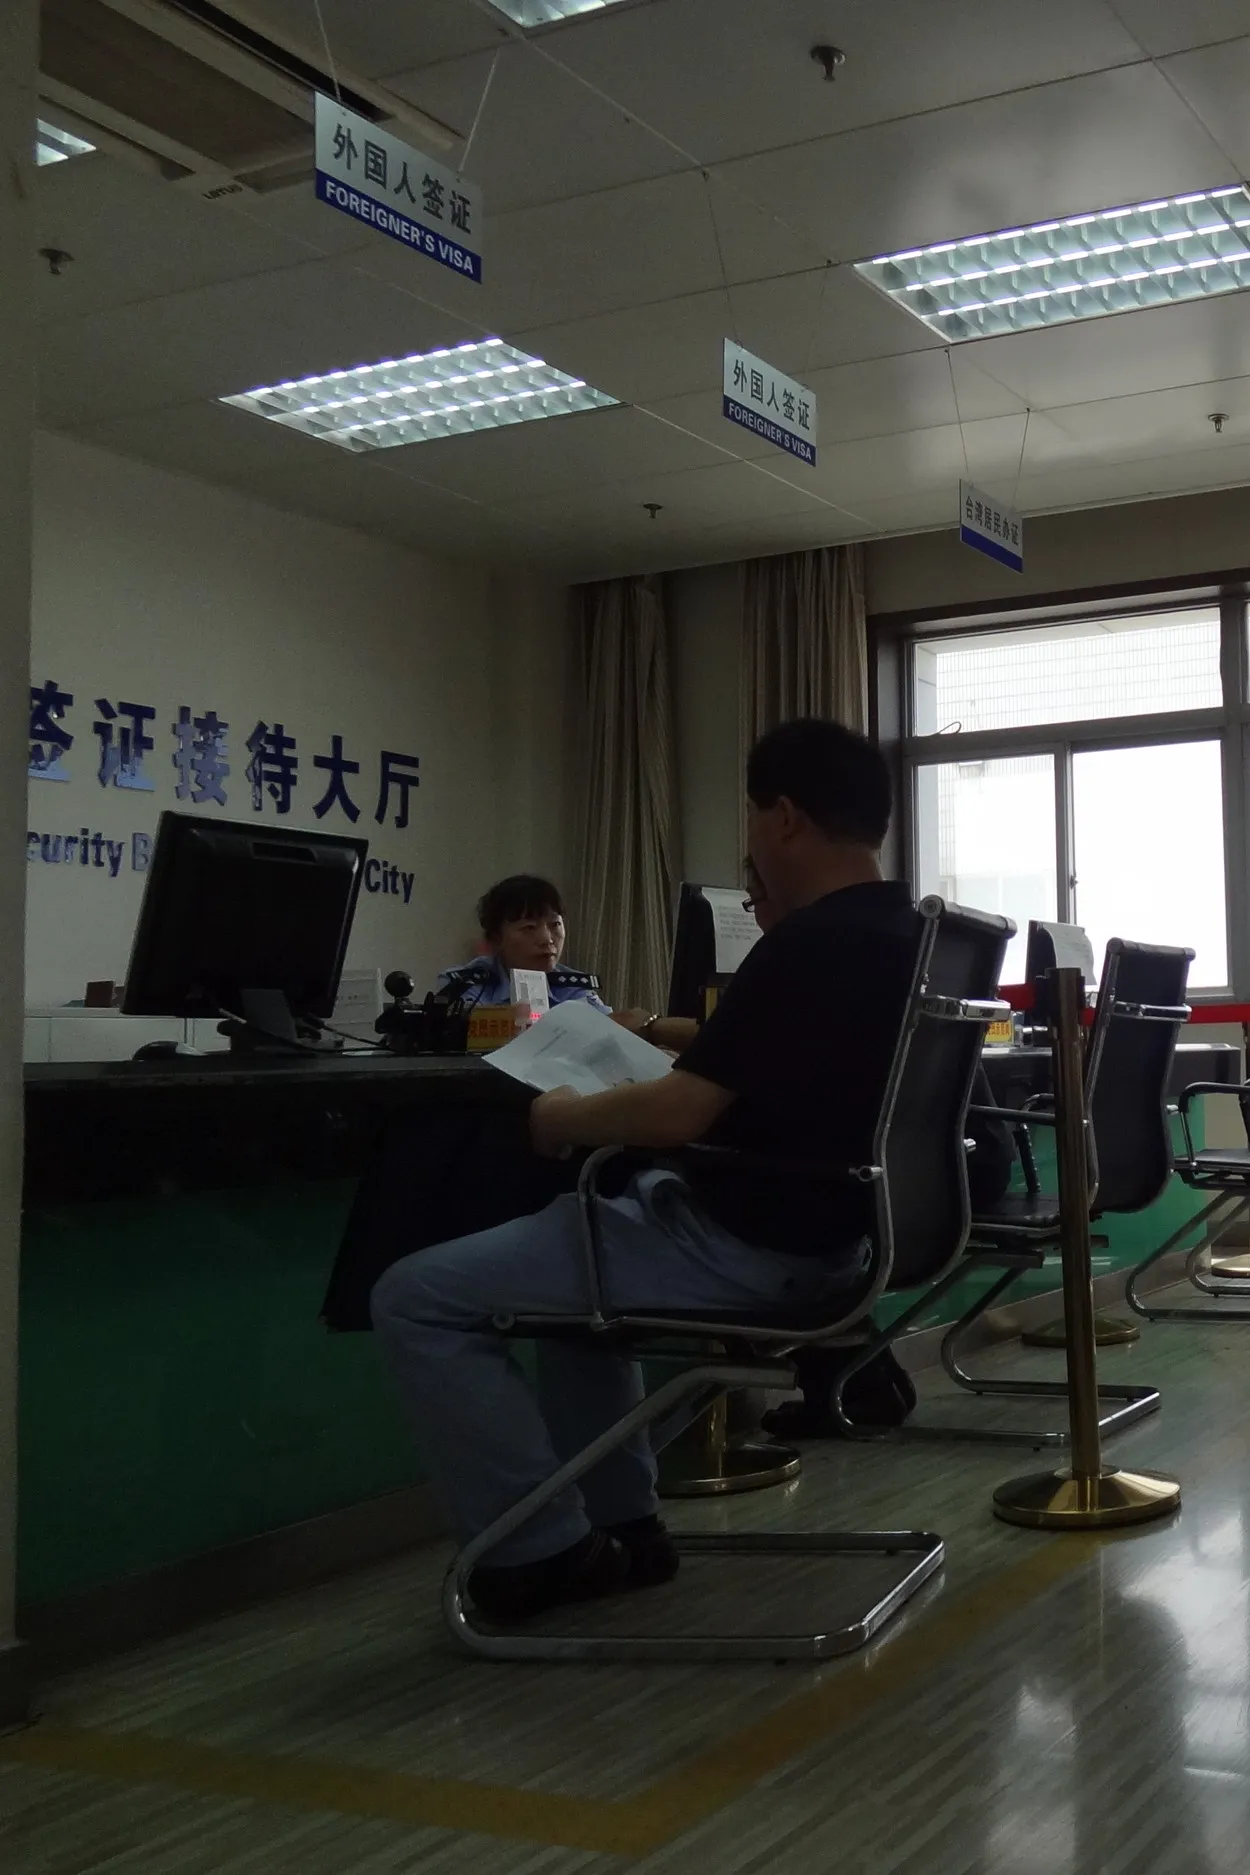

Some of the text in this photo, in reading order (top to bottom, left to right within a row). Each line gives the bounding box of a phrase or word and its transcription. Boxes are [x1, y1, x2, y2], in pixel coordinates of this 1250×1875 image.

[332, 123, 471, 235] 外国人签证
[325, 180, 474, 275] FOREIGNER'S VISA
[728, 402, 812, 460] FOREIGNER'S VISA
[733, 359, 810, 431] 外国人签证
[26, 828, 125, 877] curity
[365, 858, 415, 903] City
